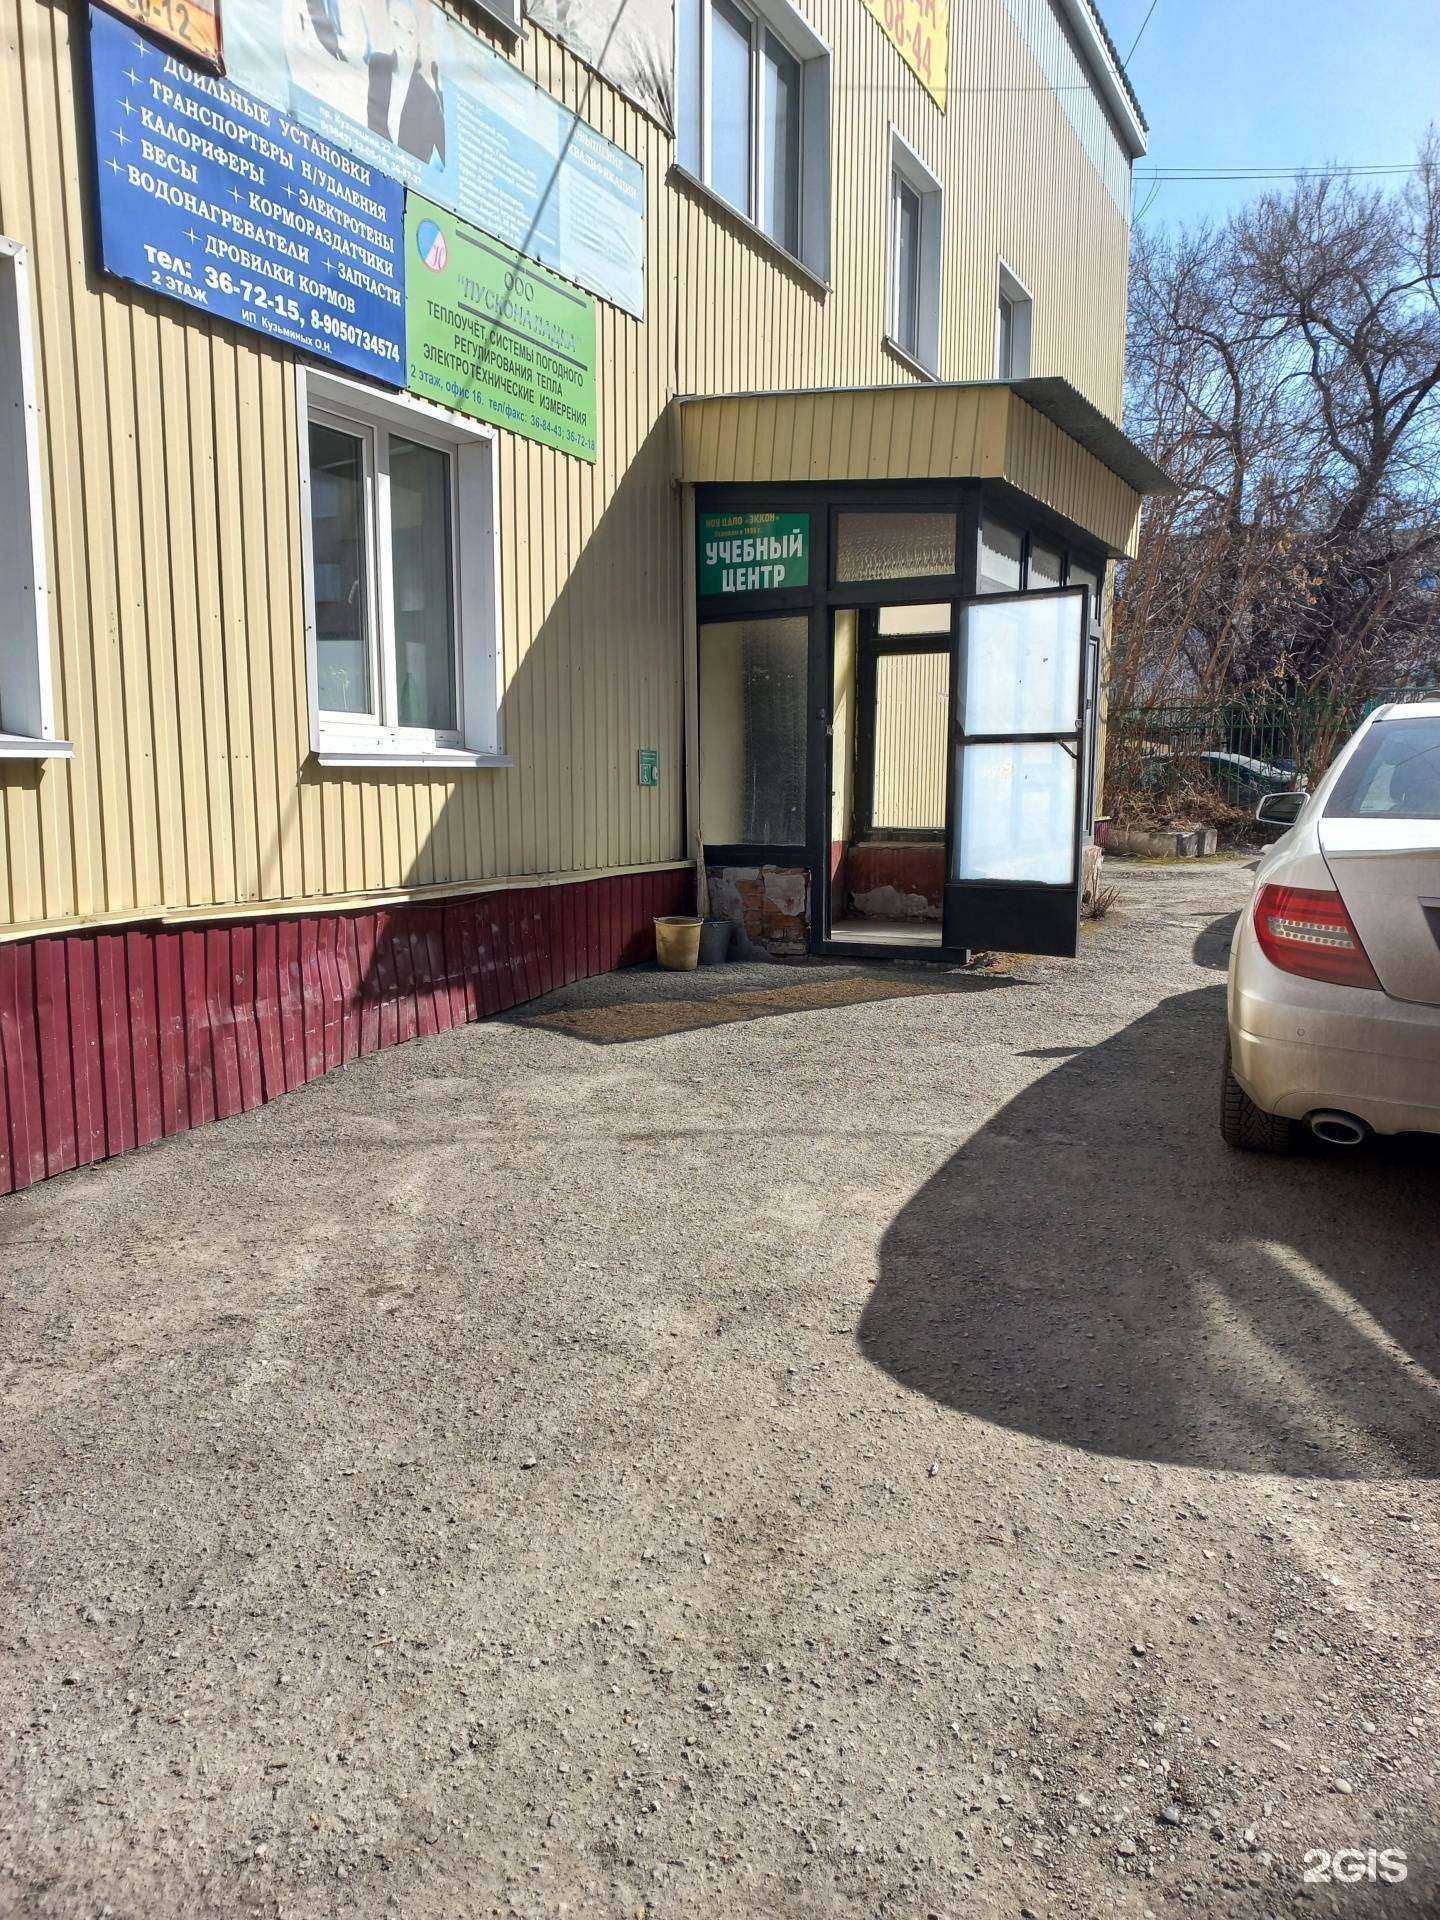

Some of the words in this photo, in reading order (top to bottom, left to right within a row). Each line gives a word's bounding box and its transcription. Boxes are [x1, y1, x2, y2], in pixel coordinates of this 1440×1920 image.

[140, 106, 265, 186] КАЛОРИФЕРЫ
[299, 188, 395, 253] ЭЛЕКТРОТЕНЫ
[150, 78, 294, 171] ТРАНСПОРТЕРЫ
[300, 160, 387, 223] Н/УДАЛЕНИЯ
[279, 118, 371, 187] УСТАНОВКИ
[127, 164, 310, 265] ВОДОНАГРЕВАТЕЛИ
[338, 262, 402, 307] ЗАПЧАСТИ
[141, 139, 199, 184] ВЕСЫ
[248, 191, 394, 278] КОРМОРАЗДАТЧИКИ
[151, 270, 162, 286] 2
[165, 275, 209, 305] ЭТАЖ
[205, 234, 295, 288] ДРОБИЛКИ
[298, 274, 356, 314] КОРМОВ
[504, 271, 534, 302] ООО
[204, 265, 305, 328] 36-72-15,
[310, 308, 400, 363] 8-9050734574
[241, 308, 257, 324] ИП
[261, 316, 313, 345] Кузьминых
[410, 364, 417, 378] 2
[445, 381, 470, 401] офис
[423, 343, 535, 404] ЭЛЕКТРОТЕХНИЧЕСКИЕ
[539, 394, 587, 426] ИЗМЕРЕНИЯ
[454, 334, 533, 383] РЕГУЛИРОВАНИЯ
[536, 371, 563, 398] ТЕПЛА
[489, 330, 535, 363] СИСТЕМЫ
[536, 352, 584, 387] ПОГОДНОГО
[706, 528, 803, 565] УЧЕБНЫЙ
[722, 564, 785, 593] ЦЕНТР
